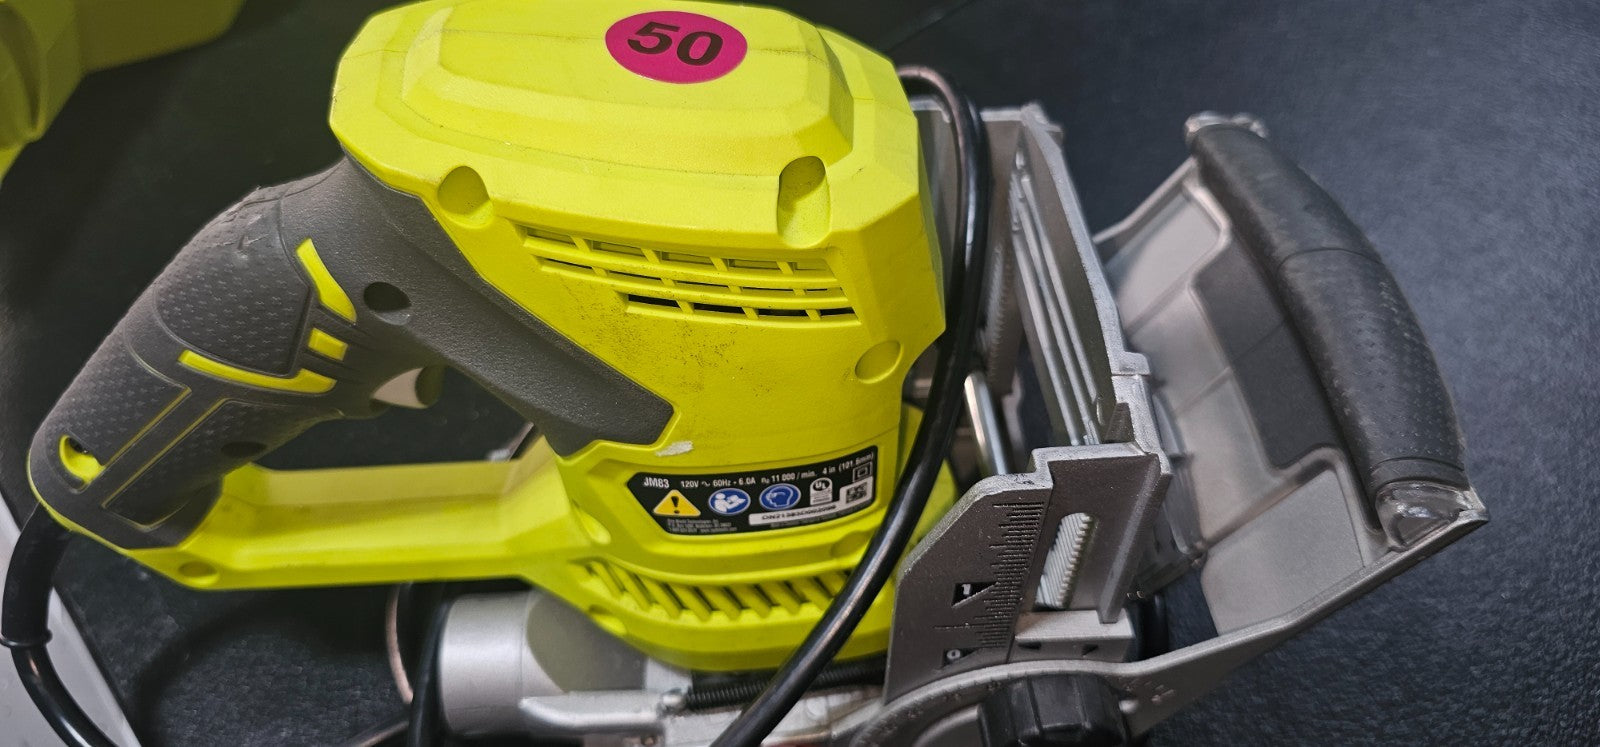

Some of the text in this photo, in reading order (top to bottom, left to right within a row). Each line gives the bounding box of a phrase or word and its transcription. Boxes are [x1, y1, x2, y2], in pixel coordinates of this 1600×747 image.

[627, 21, 724, 66] 50
[644, 477, 669, 488] JM83
[680, 480, 699, 488] 120V
[713, 479, 731, 487] 60Hz
[738, 477, 756, 486] 6.0A
[771, 474, 780, 482] 11
[782, 472, 795, 481] 000
[823, 467, 827, 475] 4
[961, 584, 971, 595] 1
